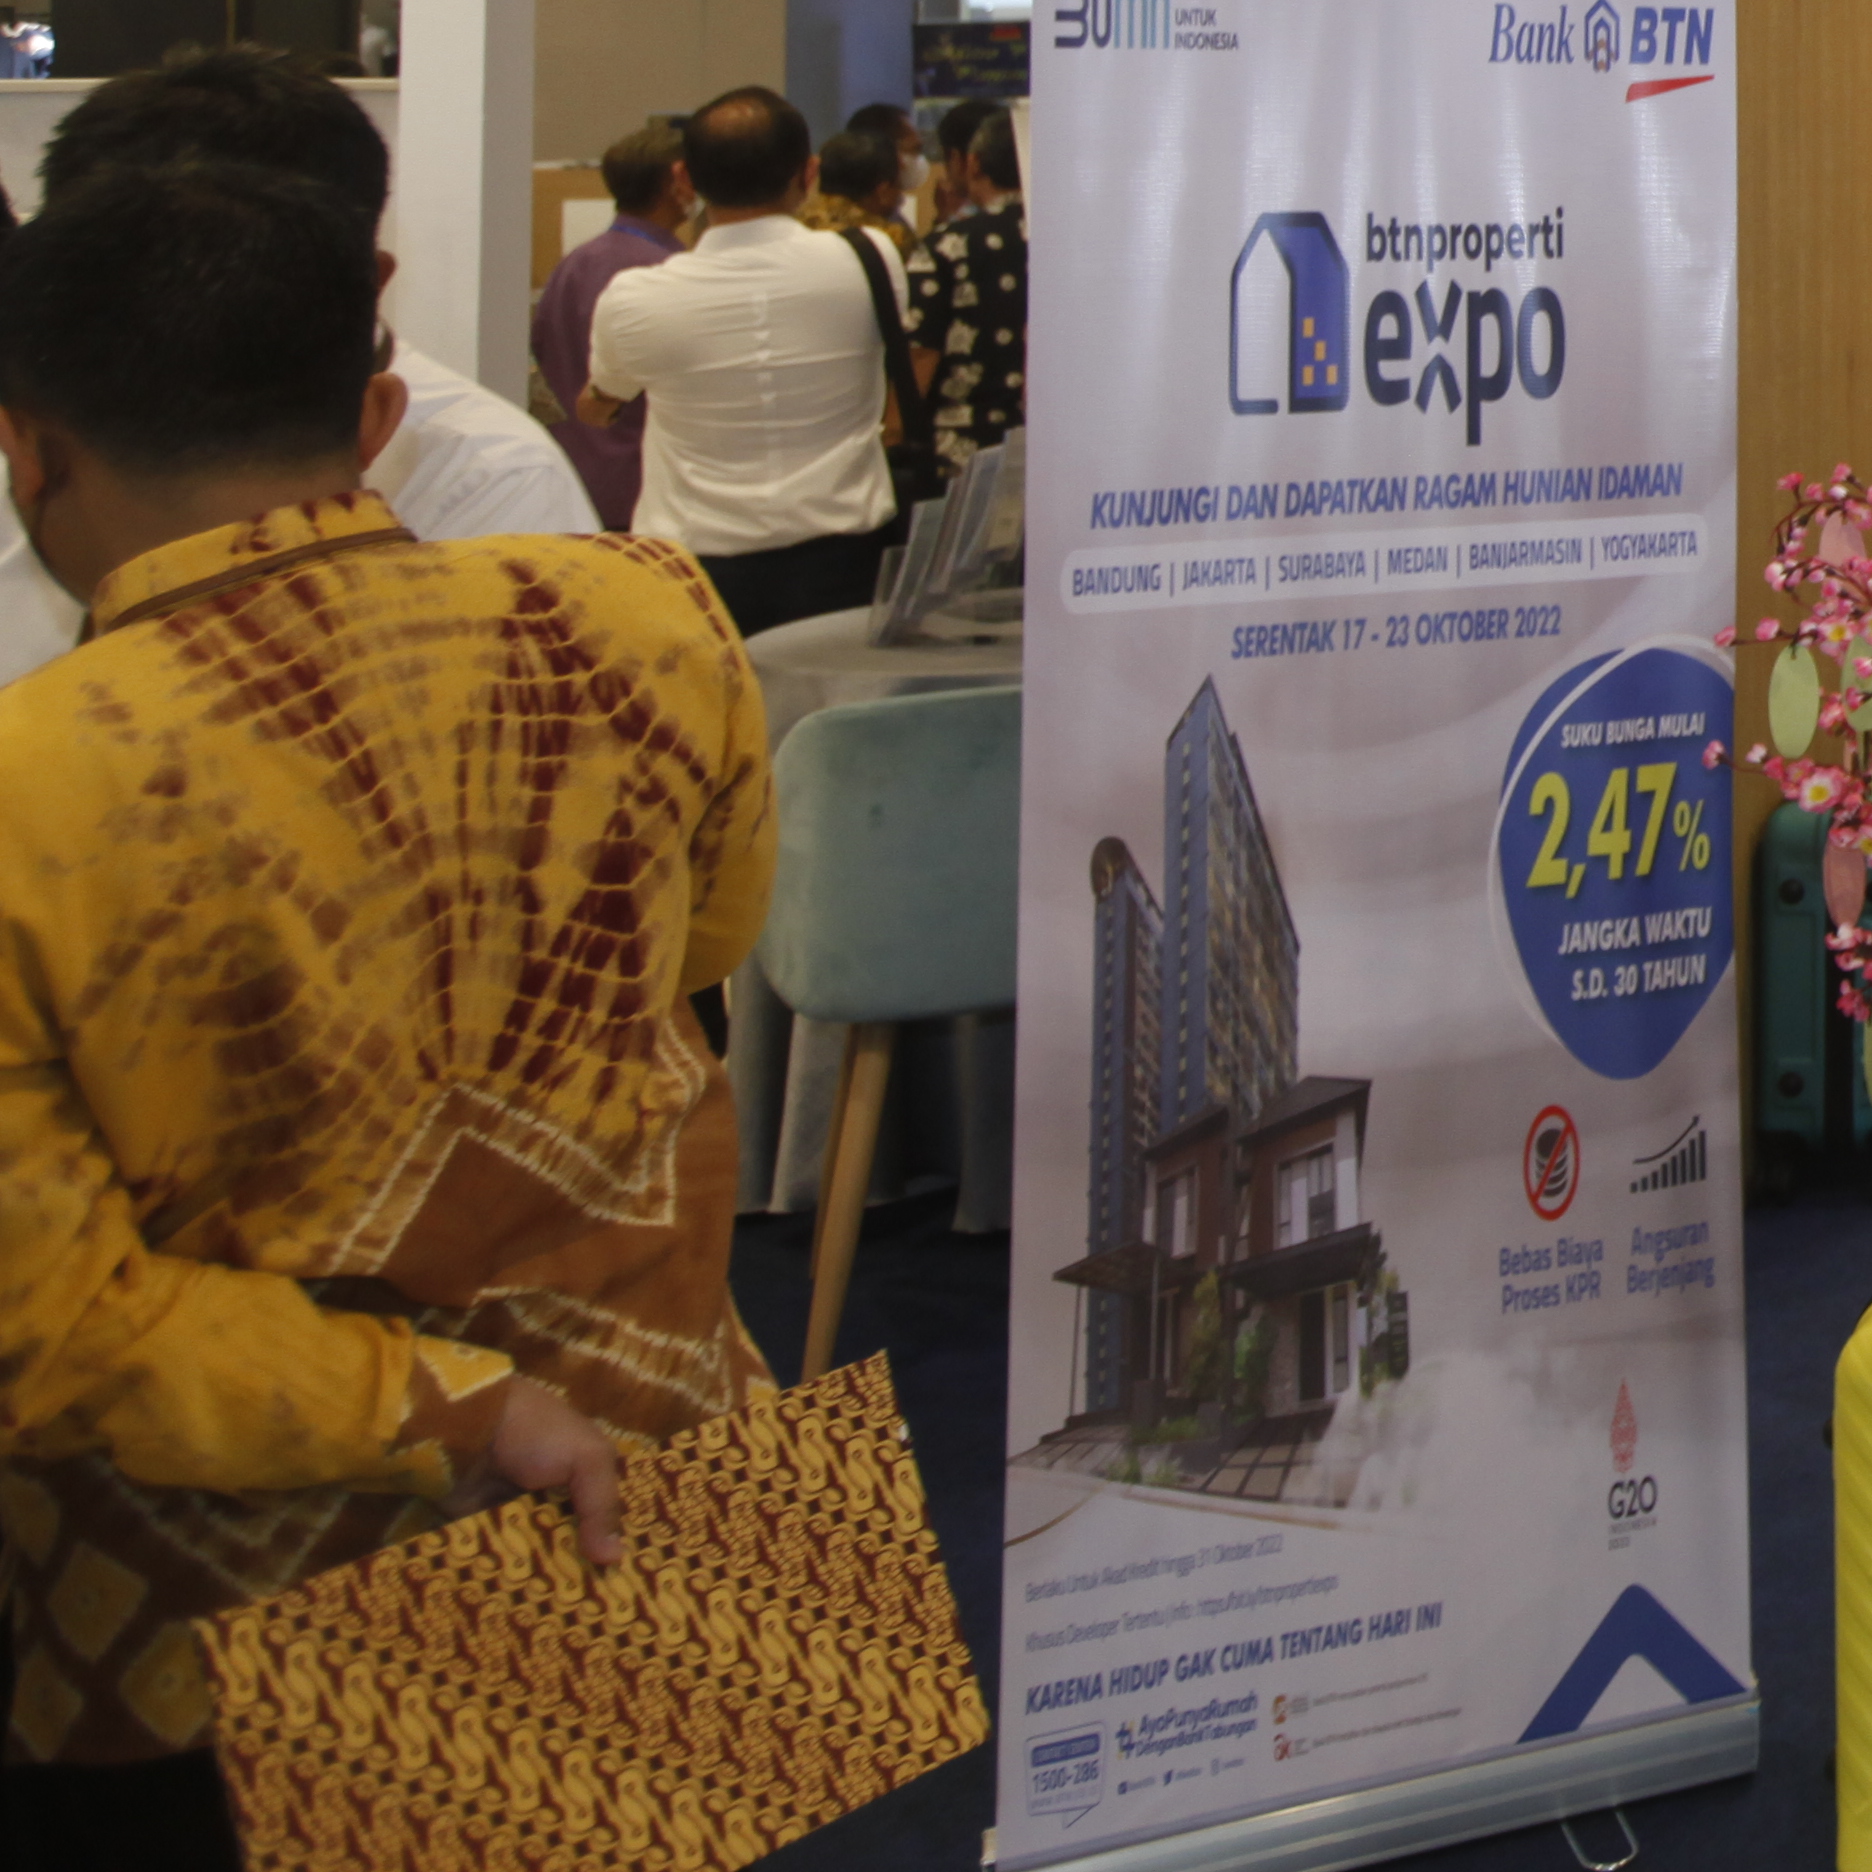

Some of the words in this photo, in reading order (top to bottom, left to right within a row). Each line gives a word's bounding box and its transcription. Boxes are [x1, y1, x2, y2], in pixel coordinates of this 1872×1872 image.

[1175, 8, 1217, 27] UNTUK
[1489, 2, 1575, 65] Bank
[1628, 6, 1714, 65] BTN
[1174, 32, 1239, 51] INDONESIA
[1365, 206, 1564, 271] btnproperti
[1363, 278, 1566, 446] expo
[1090, 488, 1218, 529] KUNJUNGI
[1226, 482, 1278, 522] DAN
[1284, 474, 1407, 519] DAPATKAN
[1413, 470, 1497, 511] RAGAM
[1502, 466, 1593, 506] HUNIAN
[1599, 462, 1683, 501] IDAMAN
[1072, 561, 1161, 597] BANDUNG
[1182, 557, 1257, 591] JAKARTA
[1278, 549, 1367, 584] SURABAYA
[1387, 544, 1448, 576] MEDAN
[1468, 537, 1583, 570] BANJARMASIN
[1601, 530, 1698, 563] YOGYAKARTA
[1231, 618, 1335, 659] SERENTAK
[1342, 616, 1367, 650] 17
[1385, 613, 1410, 648] 23
[1415, 607, 1509, 646] OKTOBER
[1514, 604, 1562, 639] 2022
[1560, 718, 1602, 748] SUKU
[1605, 715, 1656, 745] BUNGA
[1660, 712, 1706, 742] MULAI
[1525, 761, 1711, 899] 2,47%
[1558, 914, 1640, 954] JANGKA
[1645, 906, 1712, 946] WAKTU
[1571, 968, 1609, 1001] S.D.
[1614, 962, 1637, 996] 30
[1641, 954, 1706, 992] TAHUN
[1499, 1245, 1552, 1277] Bebas
[1557, 1237, 1604, 1272] Biaya
[1630, 1221, 1710, 1262] Angsuran
[1501, 1281, 1560, 1314] Proses
[1565, 1272, 1601, 1304] KPR
[1626, 1255, 1716, 1299] Berjenjang
[1608, 1474, 1659, 1520] G20
[1026, 1672, 1102, 1715] KARENA
[1109, 1658, 1170, 1697] HIDUP
[1175, 1651, 1215, 1683] GAK
[1220, 1636, 1274, 1673] CUMA
[1280, 1618, 1363, 1659] TENTANG
[1367, 1608, 1411, 1643] HARI
[1416, 1601, 1443, 1631] INI
